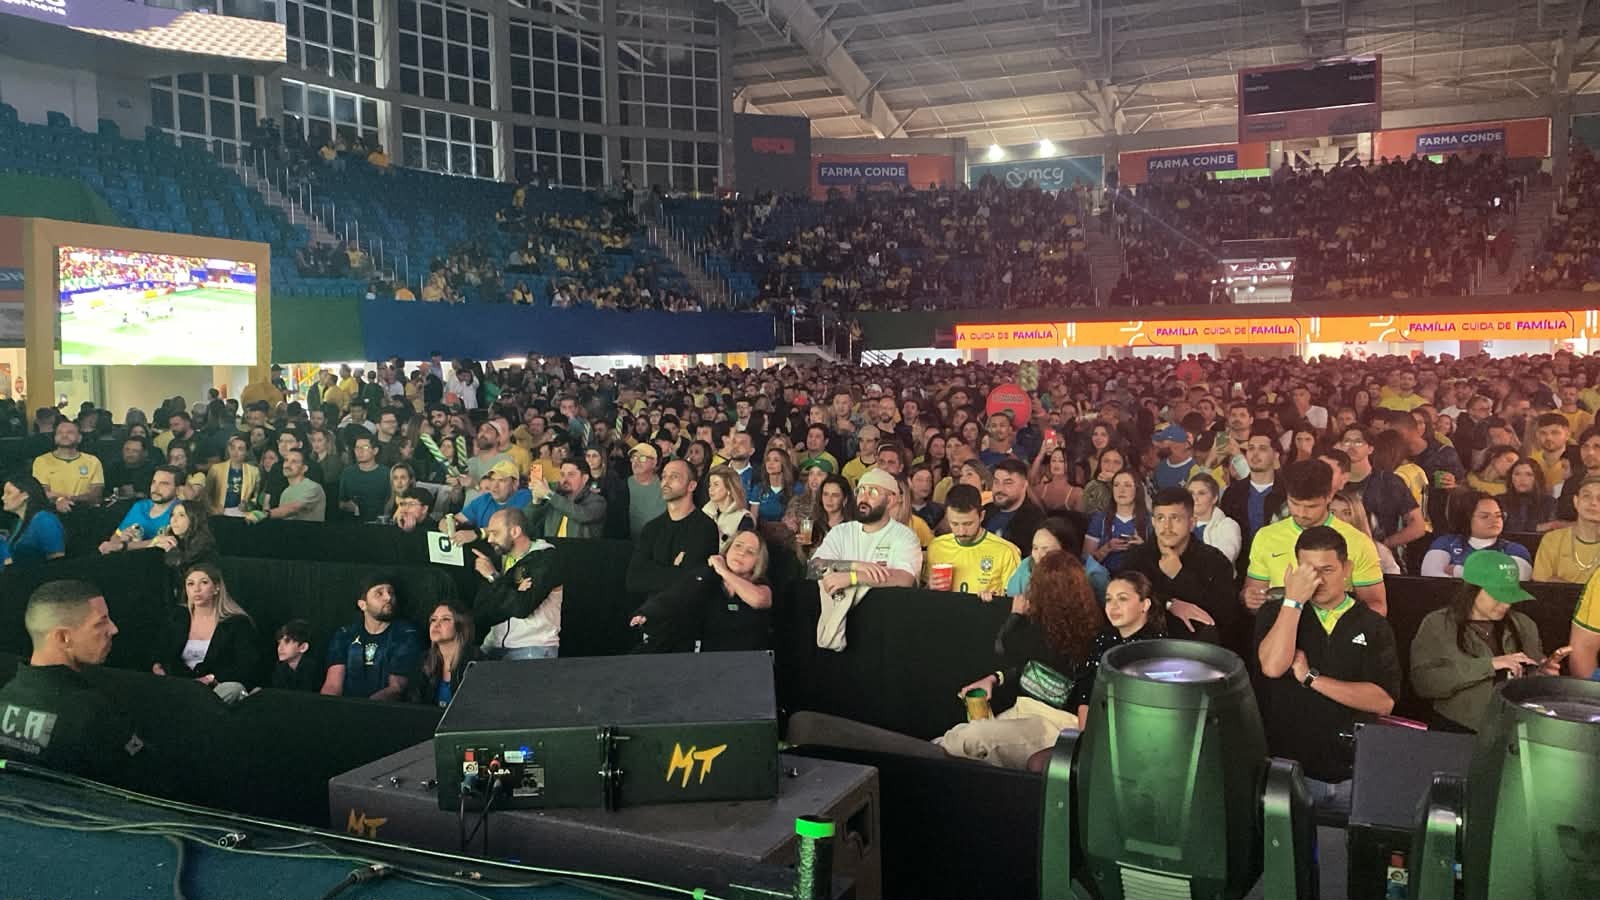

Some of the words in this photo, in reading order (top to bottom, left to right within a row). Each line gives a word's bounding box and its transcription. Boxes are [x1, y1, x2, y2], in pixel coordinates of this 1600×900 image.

[1419, 135, 1458, 146] FARMA
[1461, 132, 1503, 143] CONDE
[1149, 157, 1190, 169] FARMA
[1192, 154, 1234, 166] CONDE
[820, 167, 861, 177] FARMA
[864, 166, 906, 177] CONDE
[1028, 166, 1064, 184] mcg
[1156, 325, 1199, 336] FAMÍLIA
[1203, 327, 1232, 336] CUIDA
[1234, 326, 1247, 335] DE
[1250, 324, 1295, 335] FAMÍLIA
[1408, 320, 1456, 332] FAMÍLIA
[1461, 322, 1494, 331] CUIDA
[1497, 321, 1512, 330] DE
[1516, 319, 1567, 330] FAMÍLIA
[970, 332, 995, 341] CUIDA
[997, 331, 1009, 340] DE
[1013, 328, 1053, 340] FAMÍLIA
[666, 743, 727, 788] MT
[346, 807, 388, 840] MT
